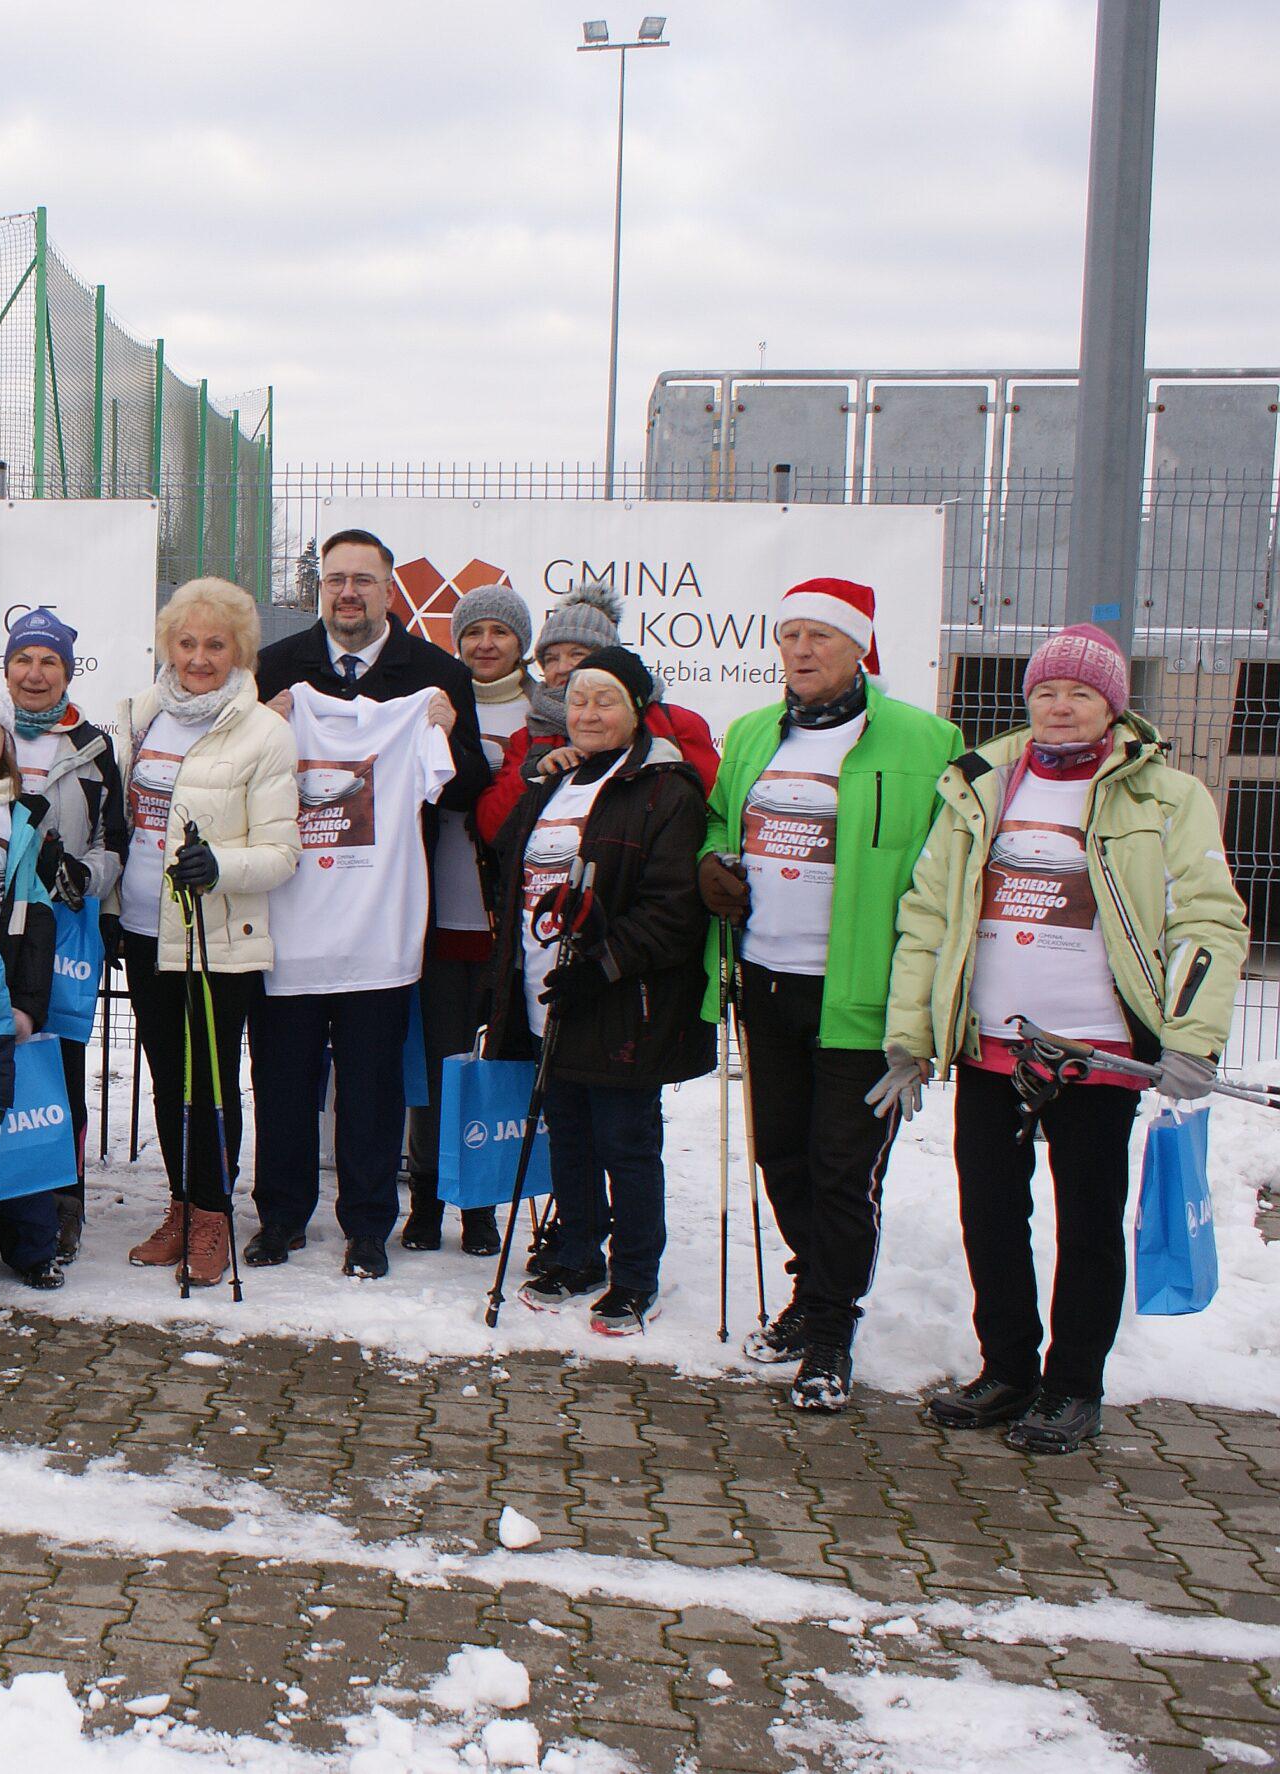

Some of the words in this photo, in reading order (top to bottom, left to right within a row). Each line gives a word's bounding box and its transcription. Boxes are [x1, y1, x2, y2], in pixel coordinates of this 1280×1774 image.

[543, 559, 702, 598] GMINA
[764, 820, 822, 835] SĄSIEDZI
[757, 828, 829, 848] ŻELAZNEGO
[764, 843, 811, 858] MOSTU
[1003, 878, 1062, 894] SĄSIEDZI
[993, 887, 1068, 909] ŻELAZNEGO
[1001, 905, 1049, 920] MOSTU
[7, 1104, 64, 1133] JAKO
